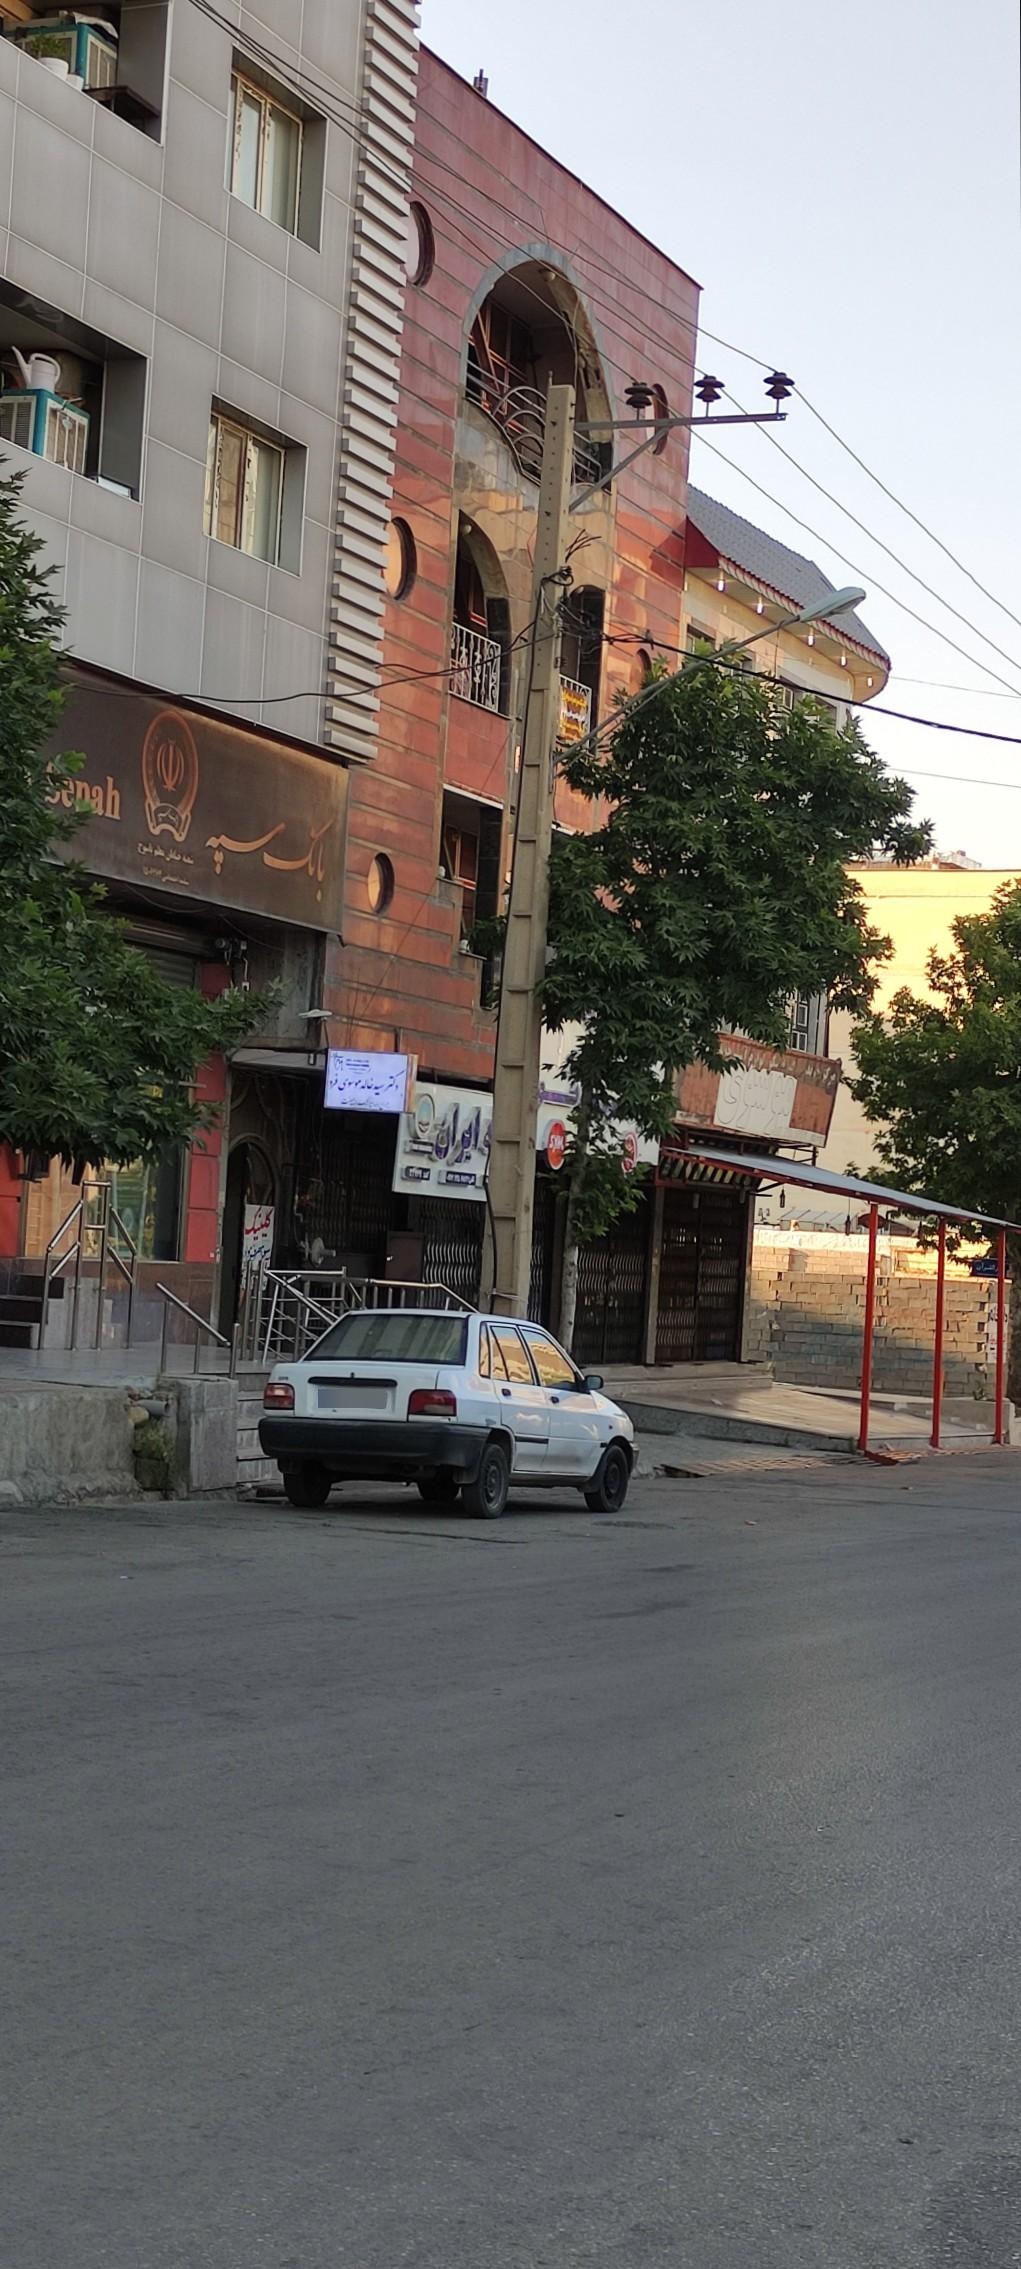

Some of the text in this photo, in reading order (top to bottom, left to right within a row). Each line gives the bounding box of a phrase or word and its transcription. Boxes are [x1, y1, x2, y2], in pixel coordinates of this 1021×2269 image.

[205, 819, 335, 901] بانک سپه
[384, 1070, 405, 1092] دکتر
[433, 1103, 482, 1164] ایران
[244, 1206, 273, 1241] کلینیک
